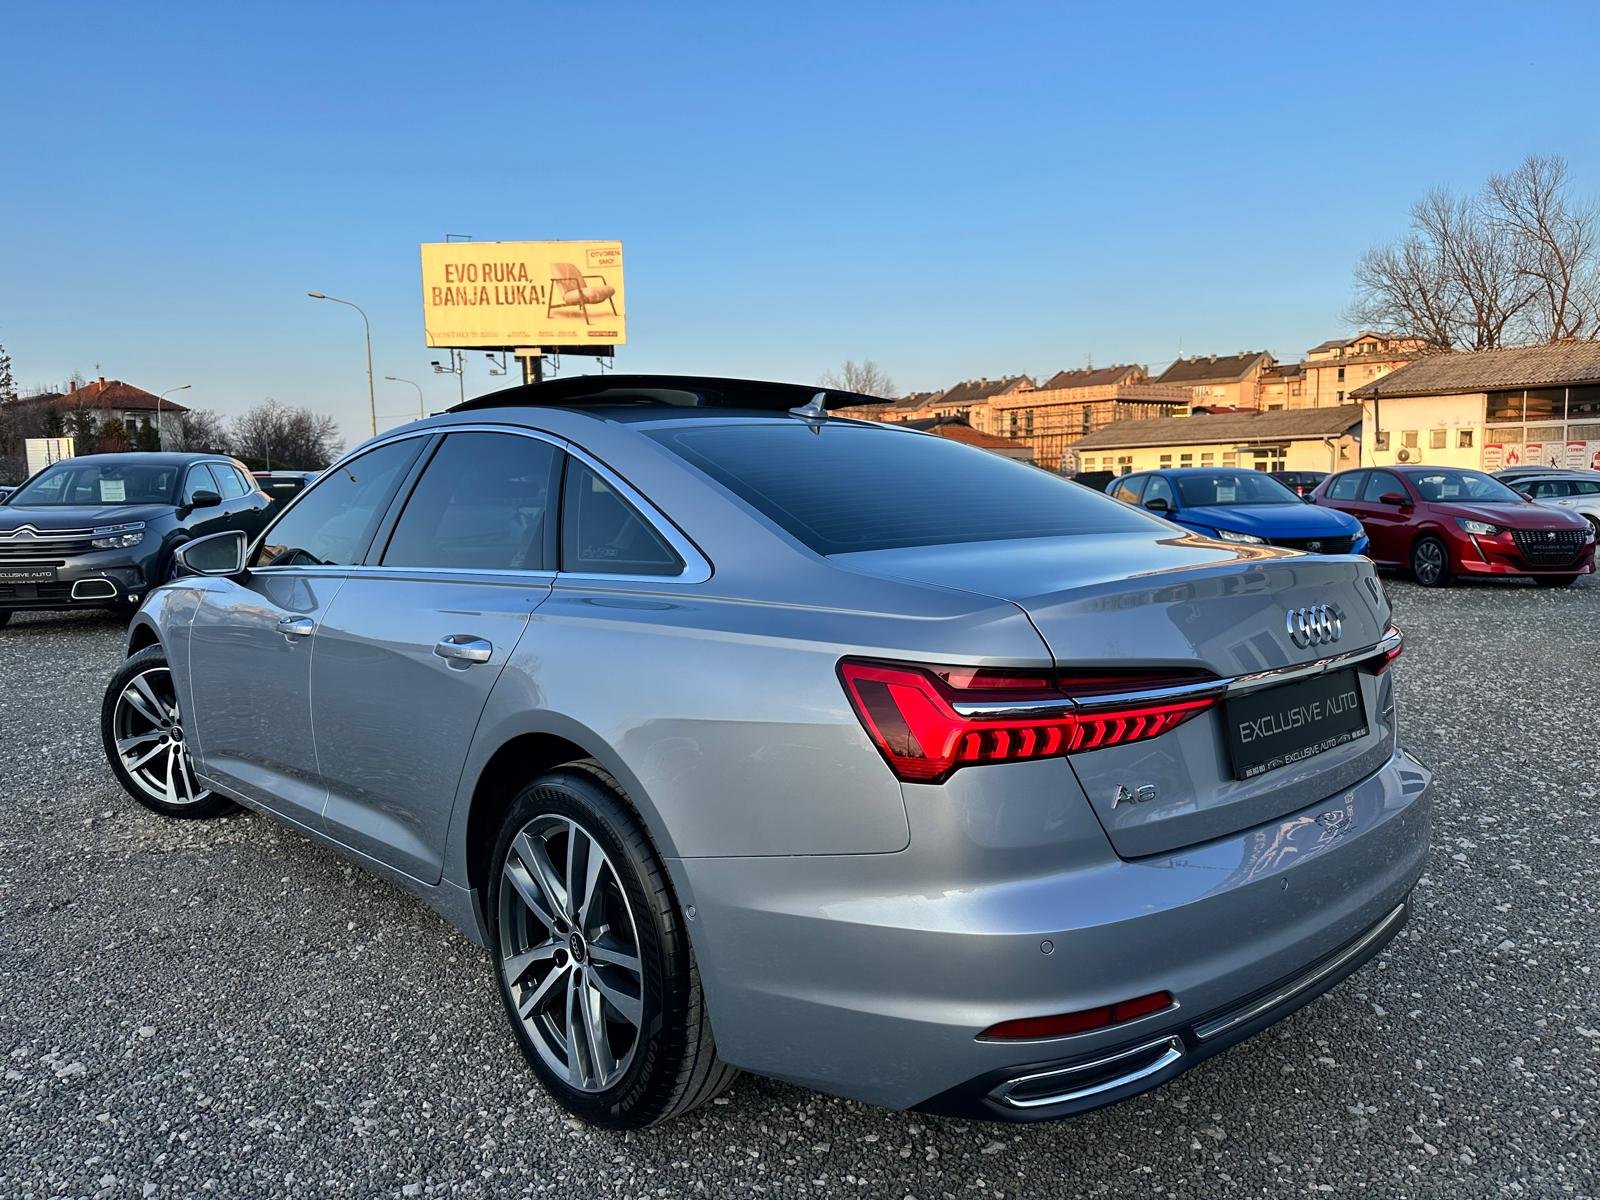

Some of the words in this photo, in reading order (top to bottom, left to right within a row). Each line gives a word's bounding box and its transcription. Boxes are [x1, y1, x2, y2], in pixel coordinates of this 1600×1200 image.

[445, 263, 477, 283] EVO
[482, 262, 533, 283] RUKA,
[432, 286, 490, 306] BANJA
[495, 285, 546, 305] LUKA!
[1239, 702, 1322, 743] EXCLUSIVE
[1326, 691, 1358, 718] AUTO
[1285, 744, 1320, 764] EXCLUSIVE
[1320, 738, 1337, 751] AUTO
[1111, 784, 1155, 809] A6
